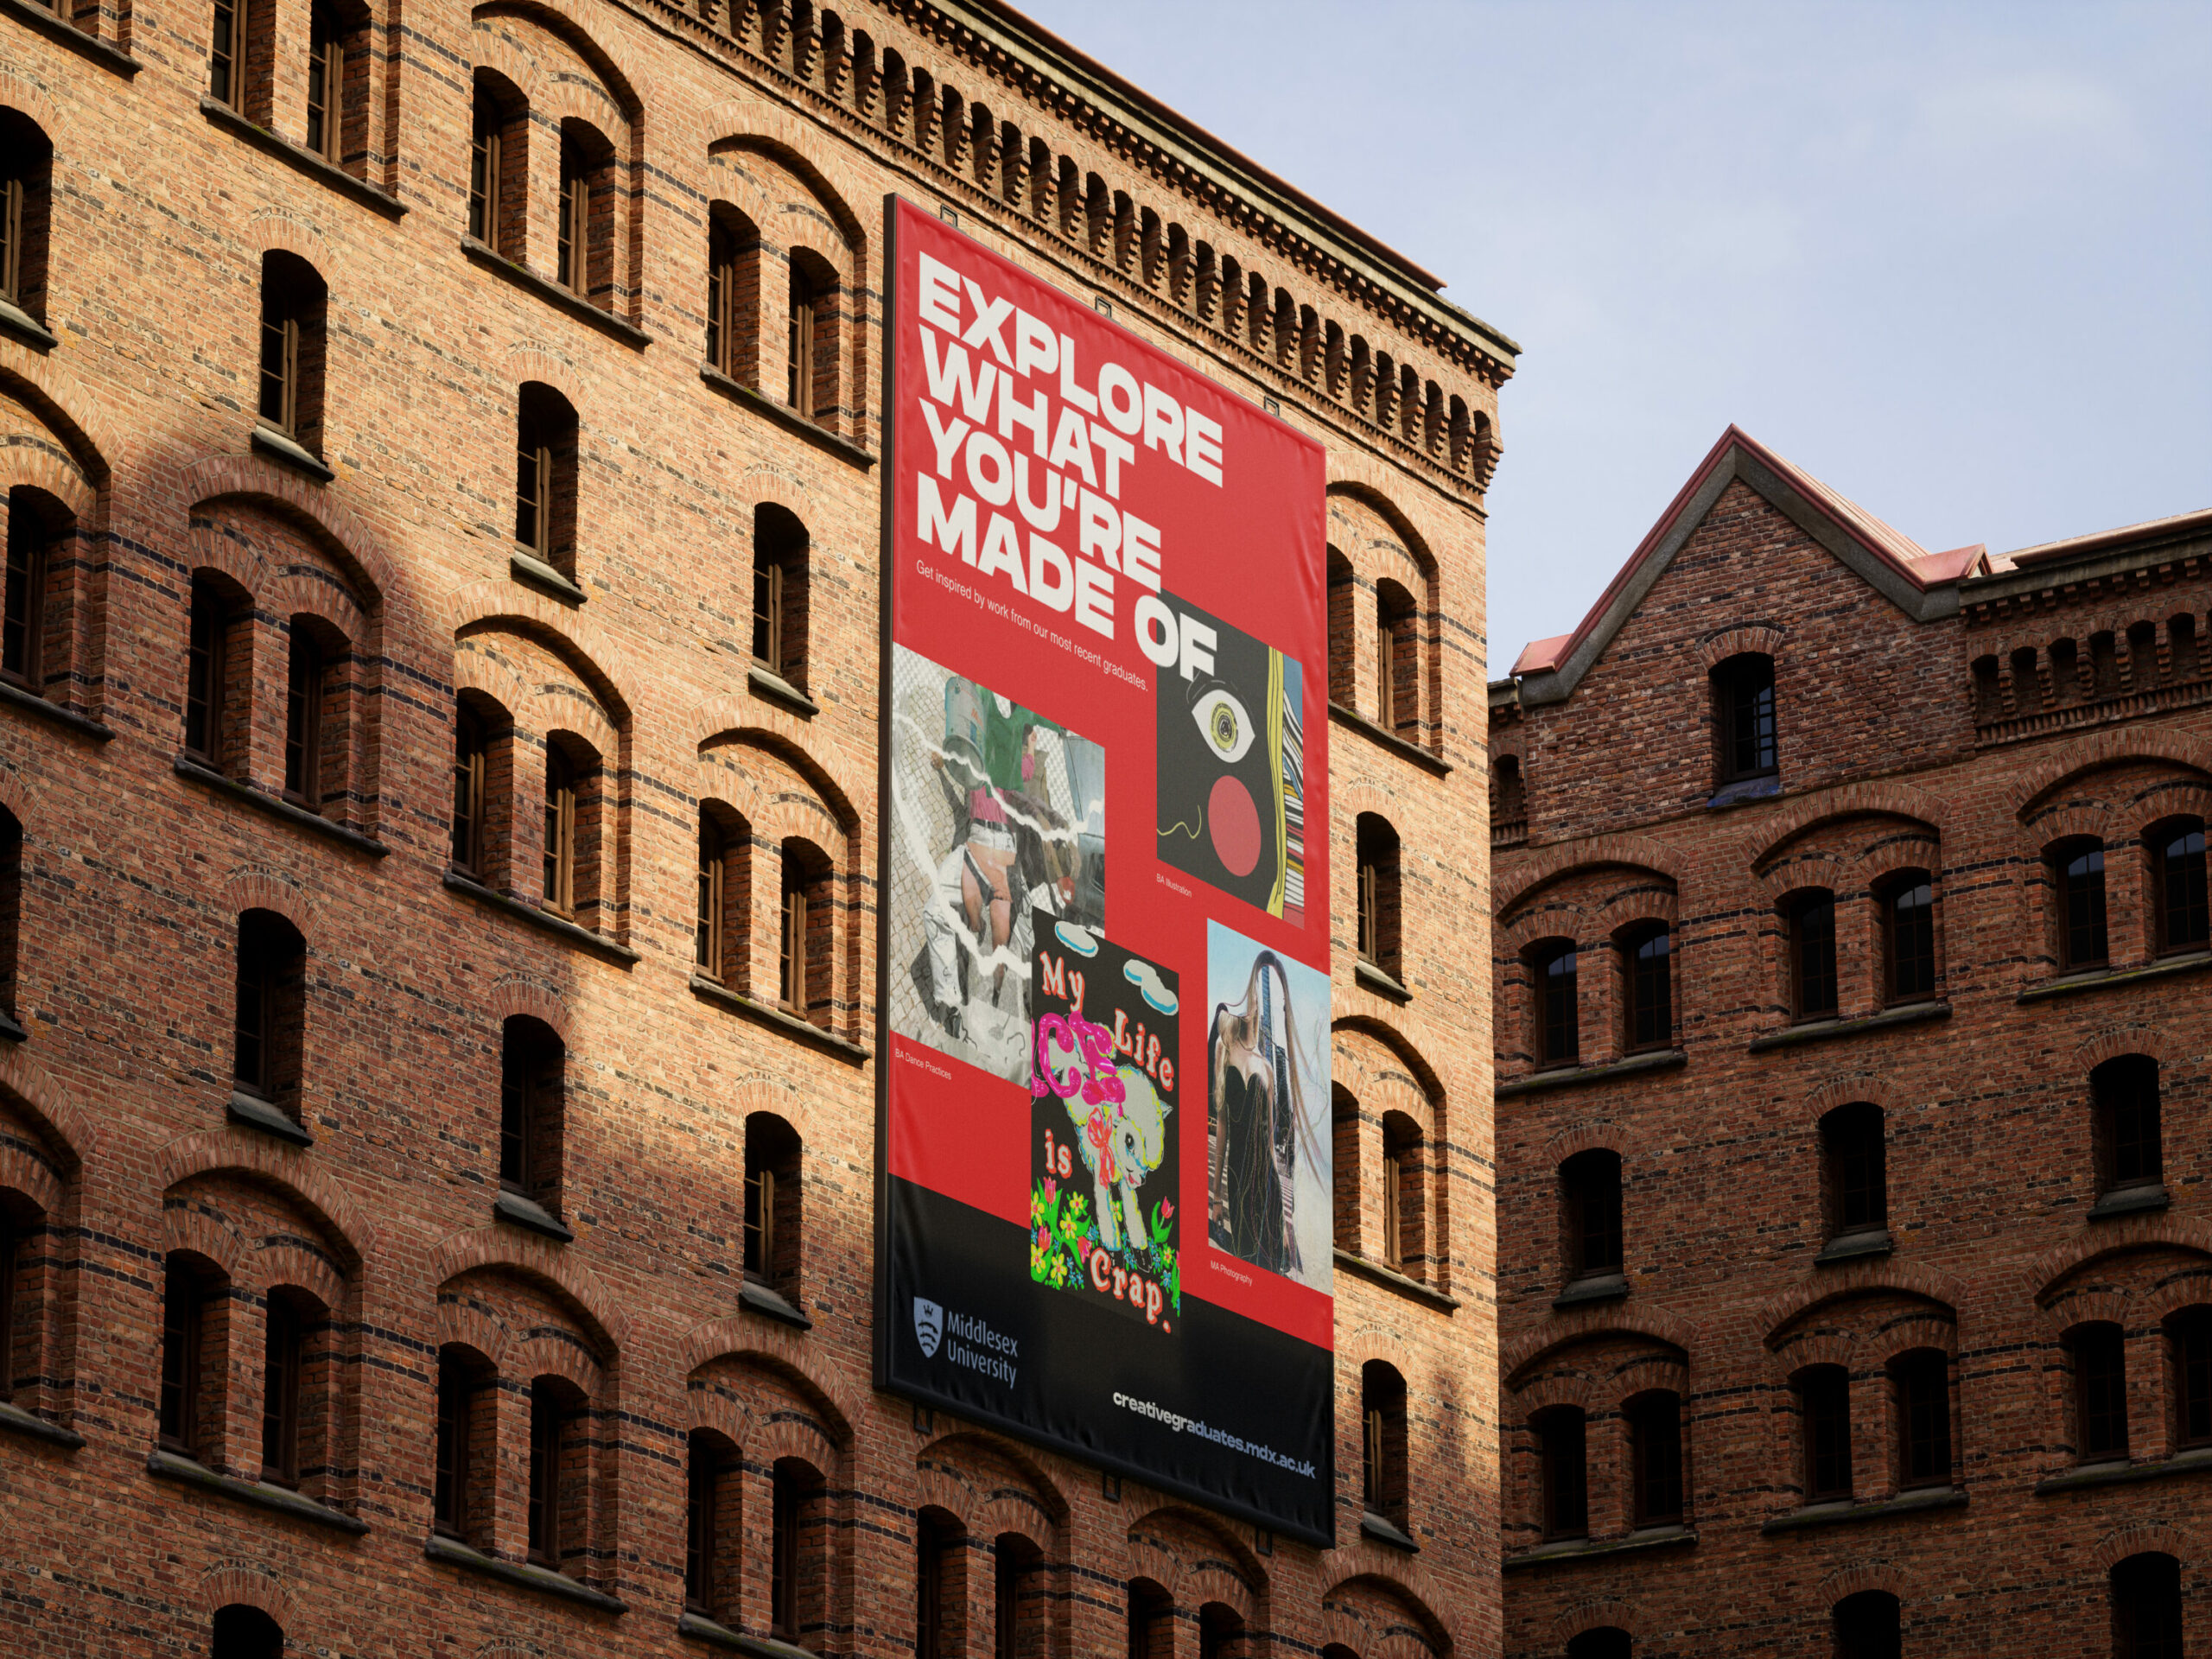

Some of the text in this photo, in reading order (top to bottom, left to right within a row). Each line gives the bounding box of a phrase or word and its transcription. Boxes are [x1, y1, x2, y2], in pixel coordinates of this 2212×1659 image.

[918, 323, 1135, 501] WHAT
[919, 251, 1223, 488] EXPLORE
[918, 397, 1161, 594] YOU'RE
[918, 471, 1217, 682] MADE OF
[916, 560, 1148, 692] Get inspired by work from our most recent graduates.
[1156, 873, 1192, 898] BA Illustration
[895, 1048, 952, 1080] BA Dance Practices
[1039, 950, 1174, 1091] My Life
[1045, 1128, 1072, 1179] is
[1090, 1247, 1172, 1333] Crap.
[1211, 1260, 1252, 1287] MA Photography
[947, 1311, 1018, 1357] Middlesex
[948, 1338, 1017, 1389] University
[1113, 1391, 1316, 1479] creativegraduates.mdx.ac.uk
